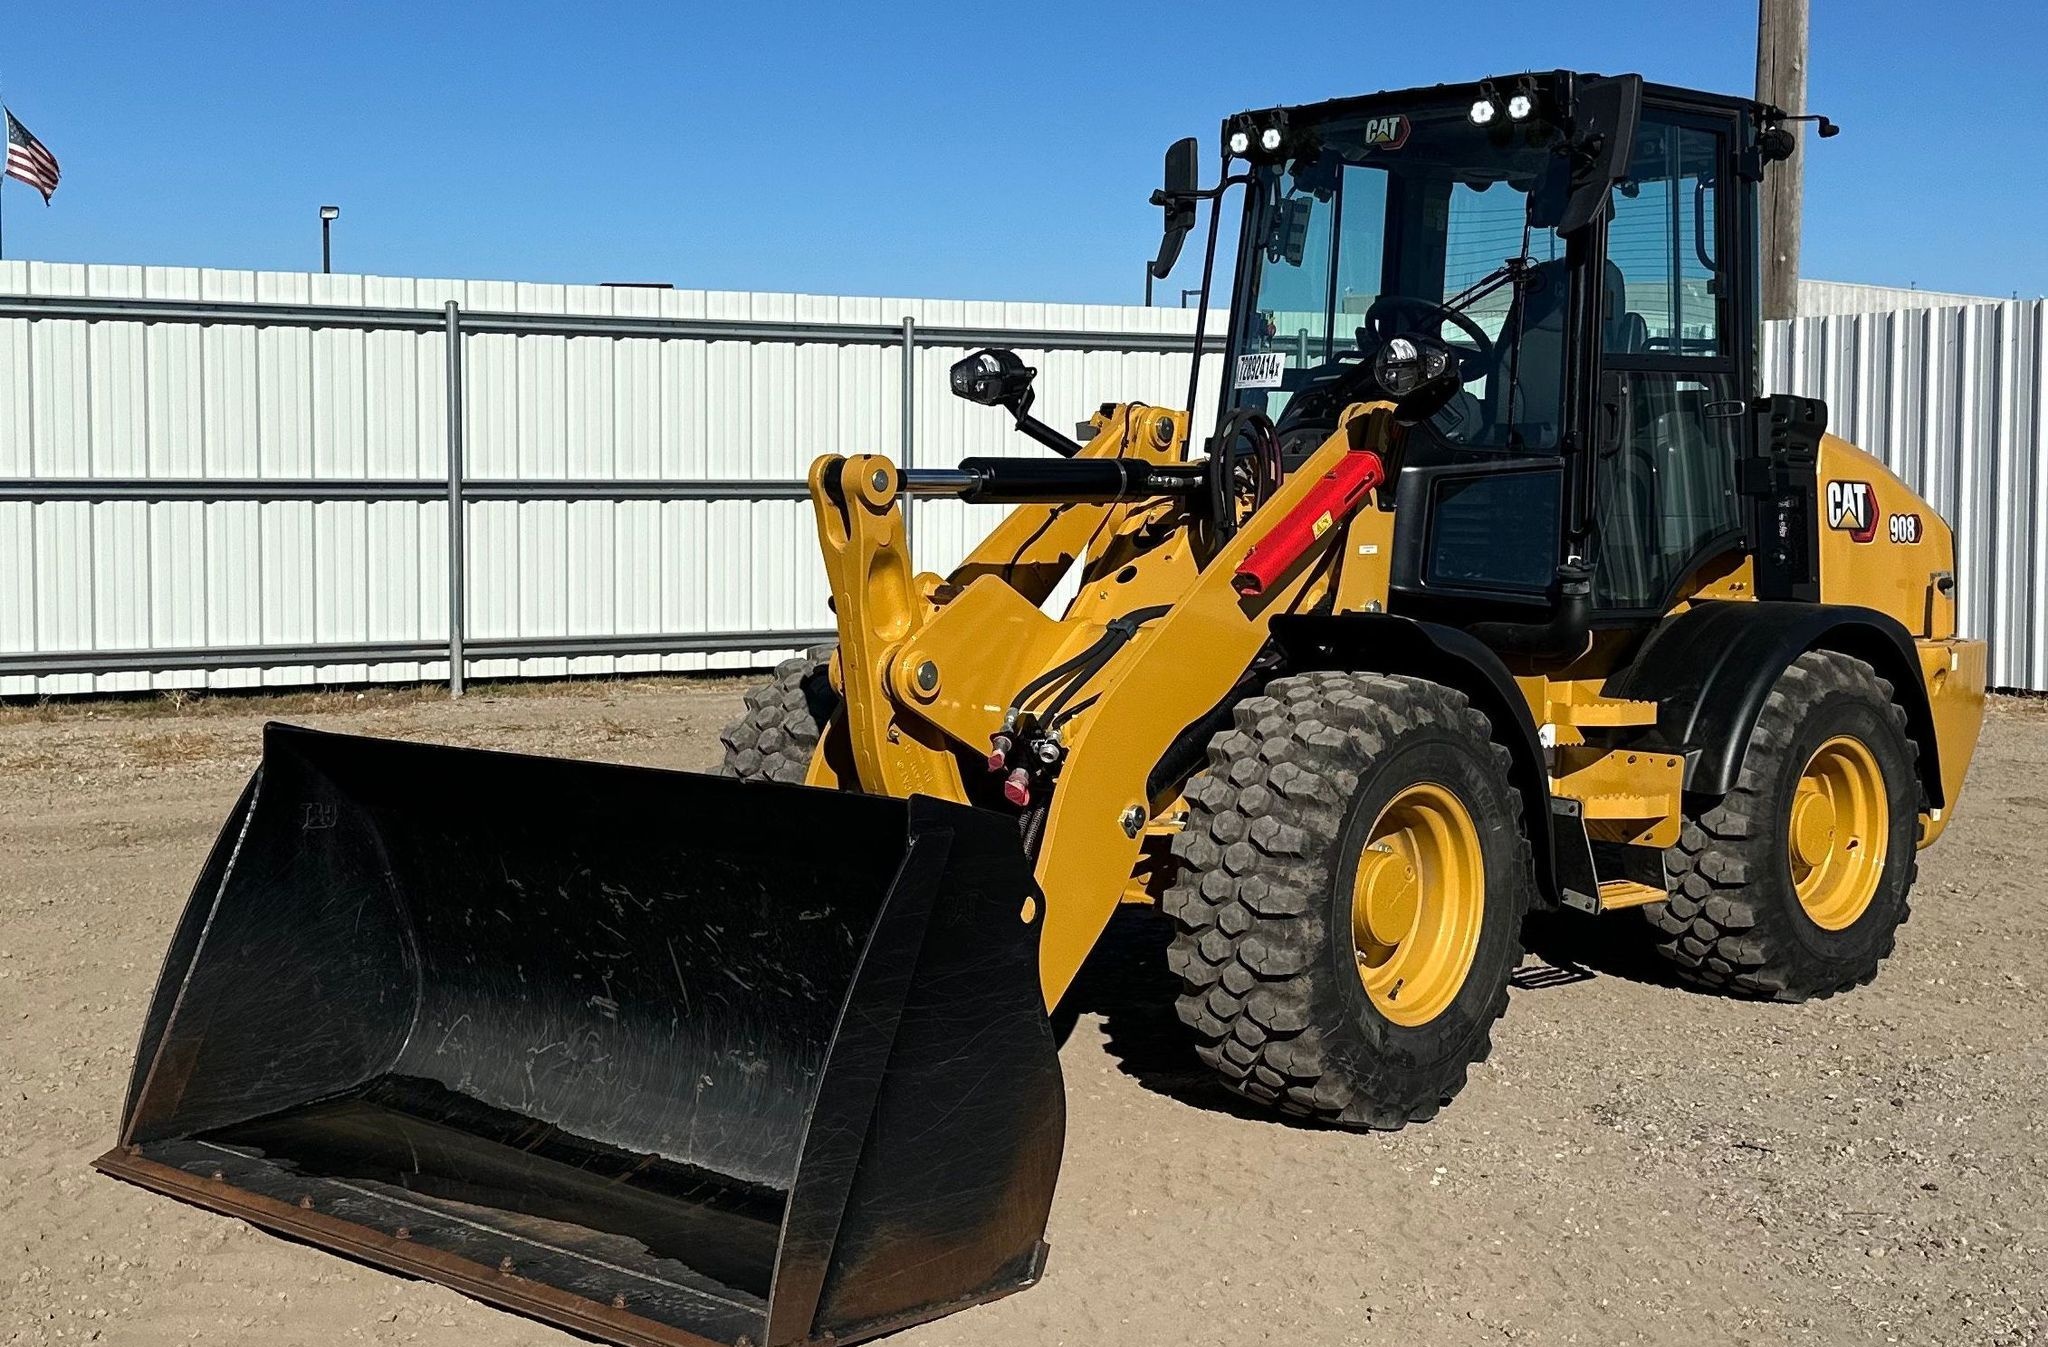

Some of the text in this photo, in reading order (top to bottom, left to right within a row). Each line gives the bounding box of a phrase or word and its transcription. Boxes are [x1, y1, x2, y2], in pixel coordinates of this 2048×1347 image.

[1365, 117, 1400, 144] CAT
[1827, 481, 1866, 528] CAT
[1889, 515, 1916, 543] 908
